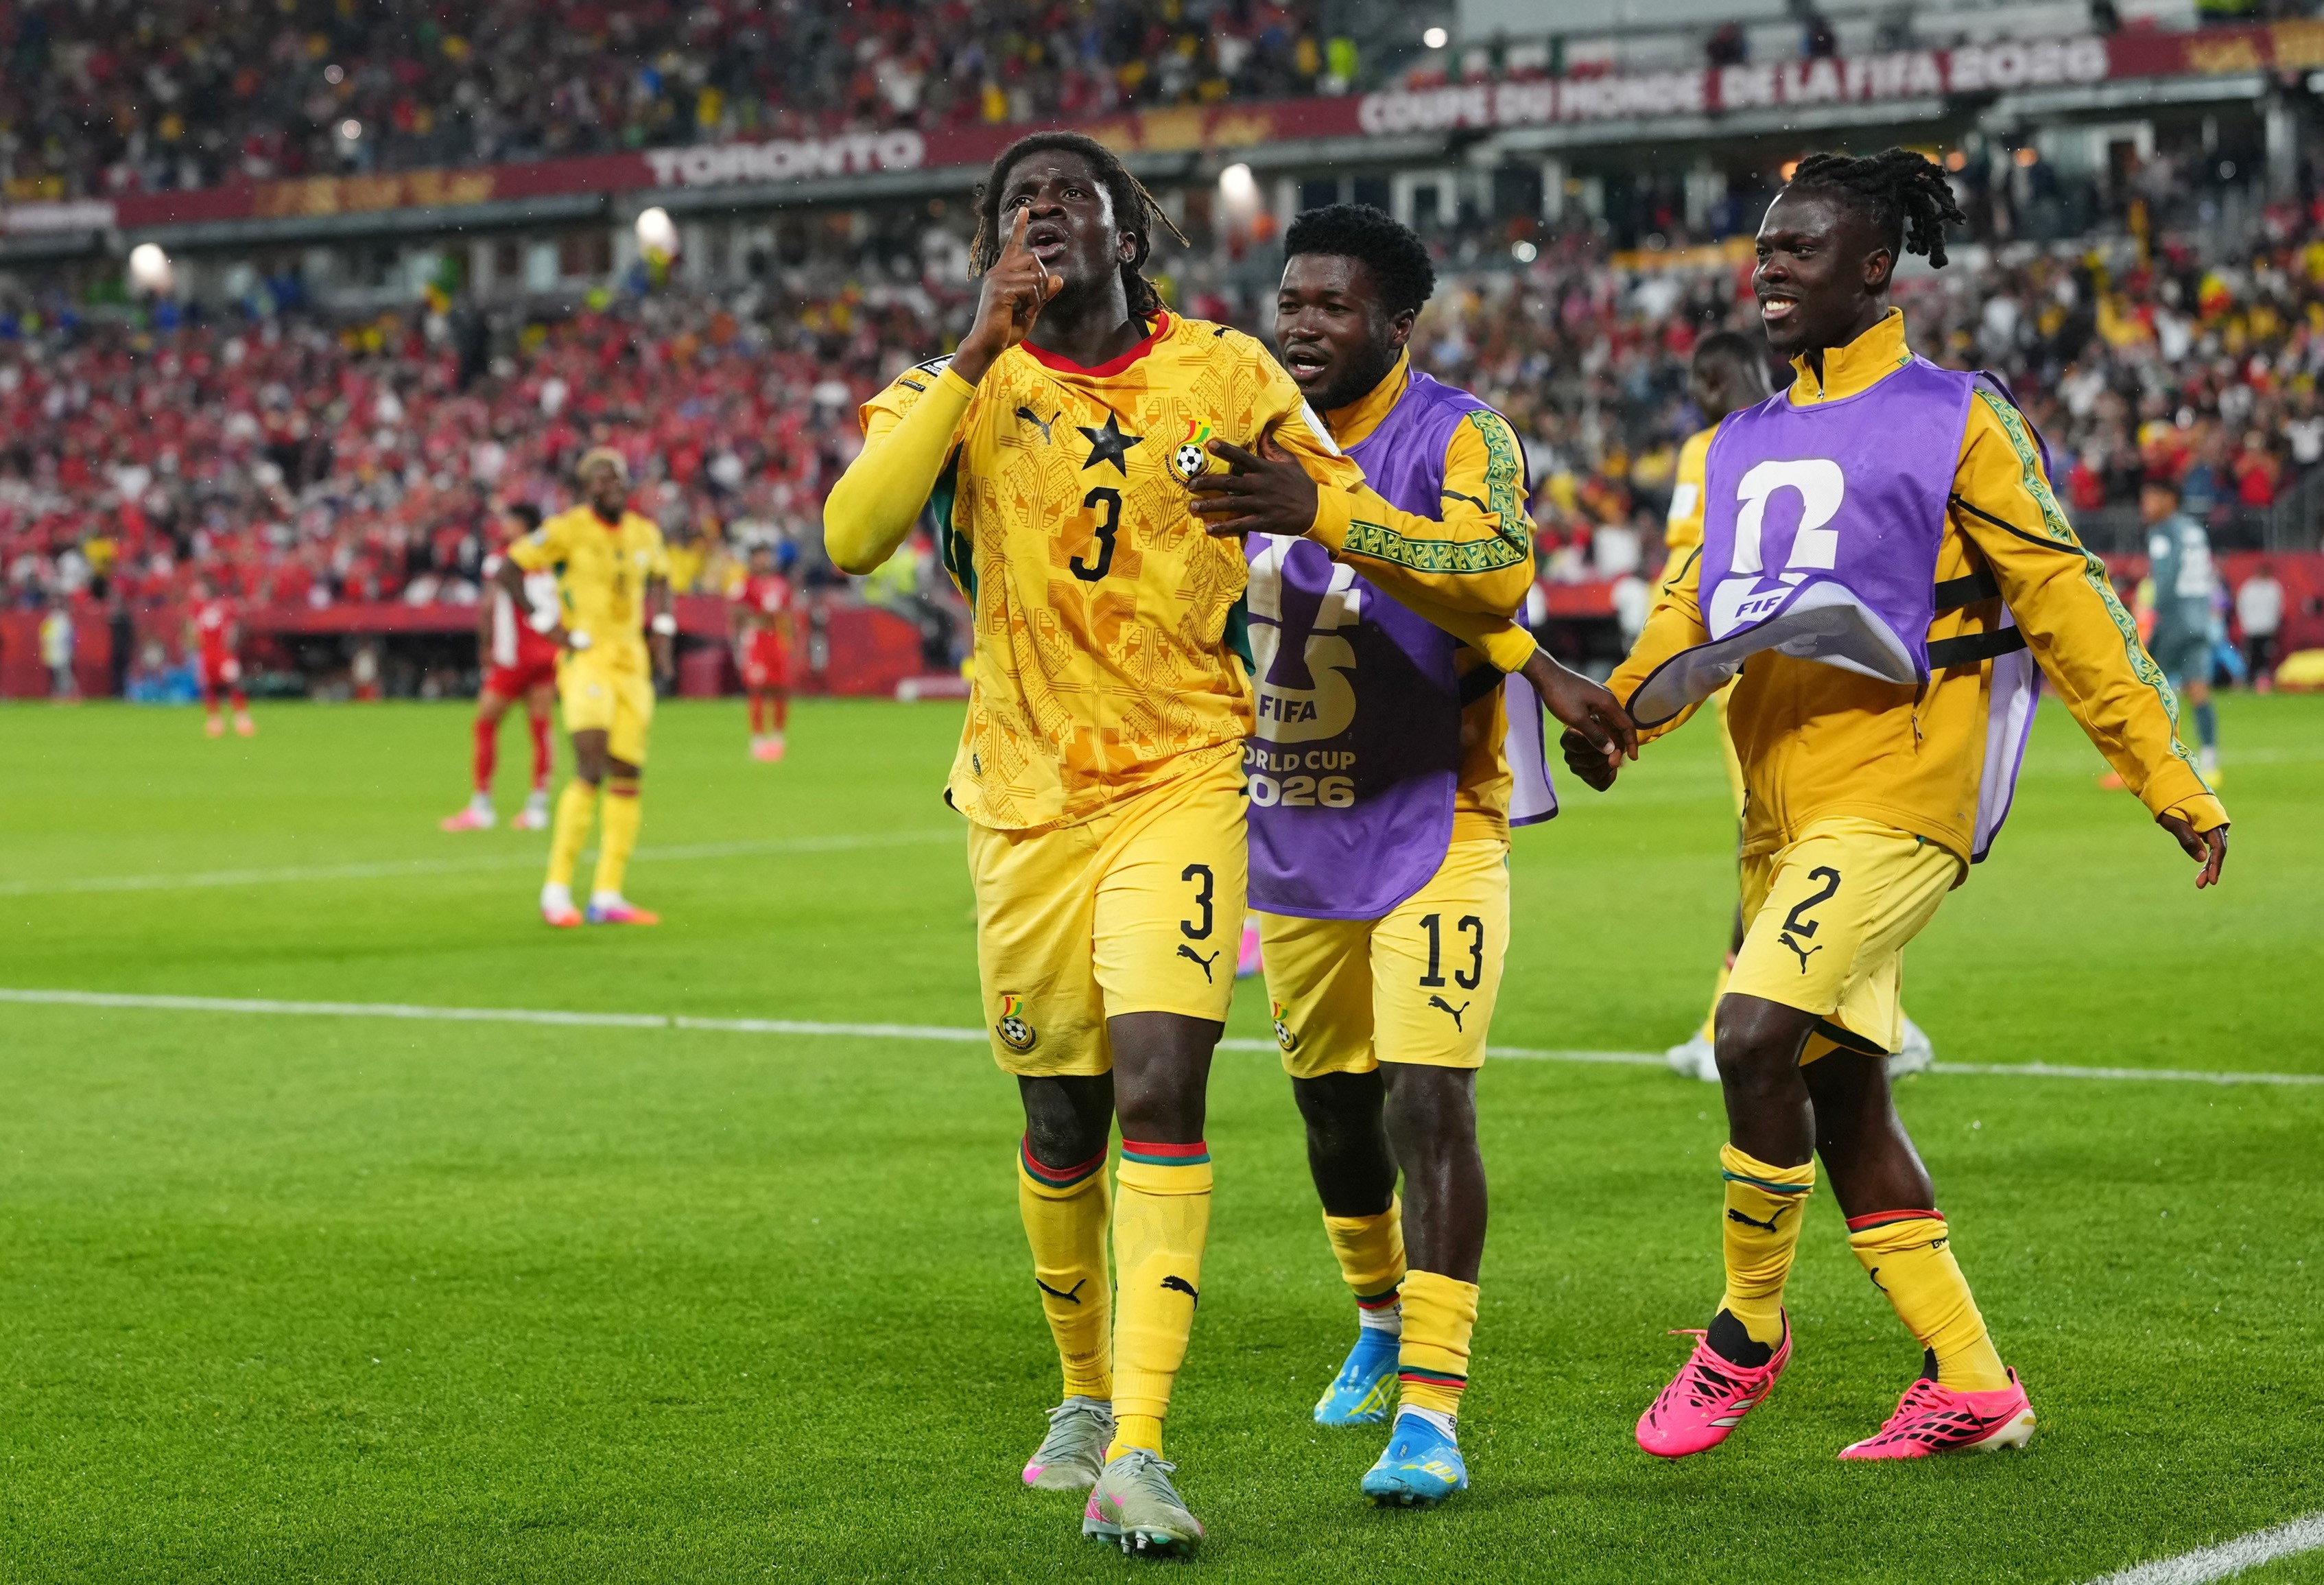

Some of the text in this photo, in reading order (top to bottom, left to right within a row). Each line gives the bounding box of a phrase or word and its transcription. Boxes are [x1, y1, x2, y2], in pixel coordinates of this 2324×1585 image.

[1783, 58, 1840, 102] LA
[1949, 38, 2109, 92] 2026
[643, 128, 925, 186] TORONTO
[904, 379, 925, 390] DEBUT
[1069, 486, 1123, 583] 3
[1735, 596, 1782, 618] FIF
[1259, 694, 1317, 723] FIFA
[1244, 745, 1356, 772] ORLD CUP
[1248, 773, 1355, 808] 026
[1181, 863, 1213, 940] 3
[1782, 866, 1841, 939] 2
[1419, 913, 1484, 990] 13
